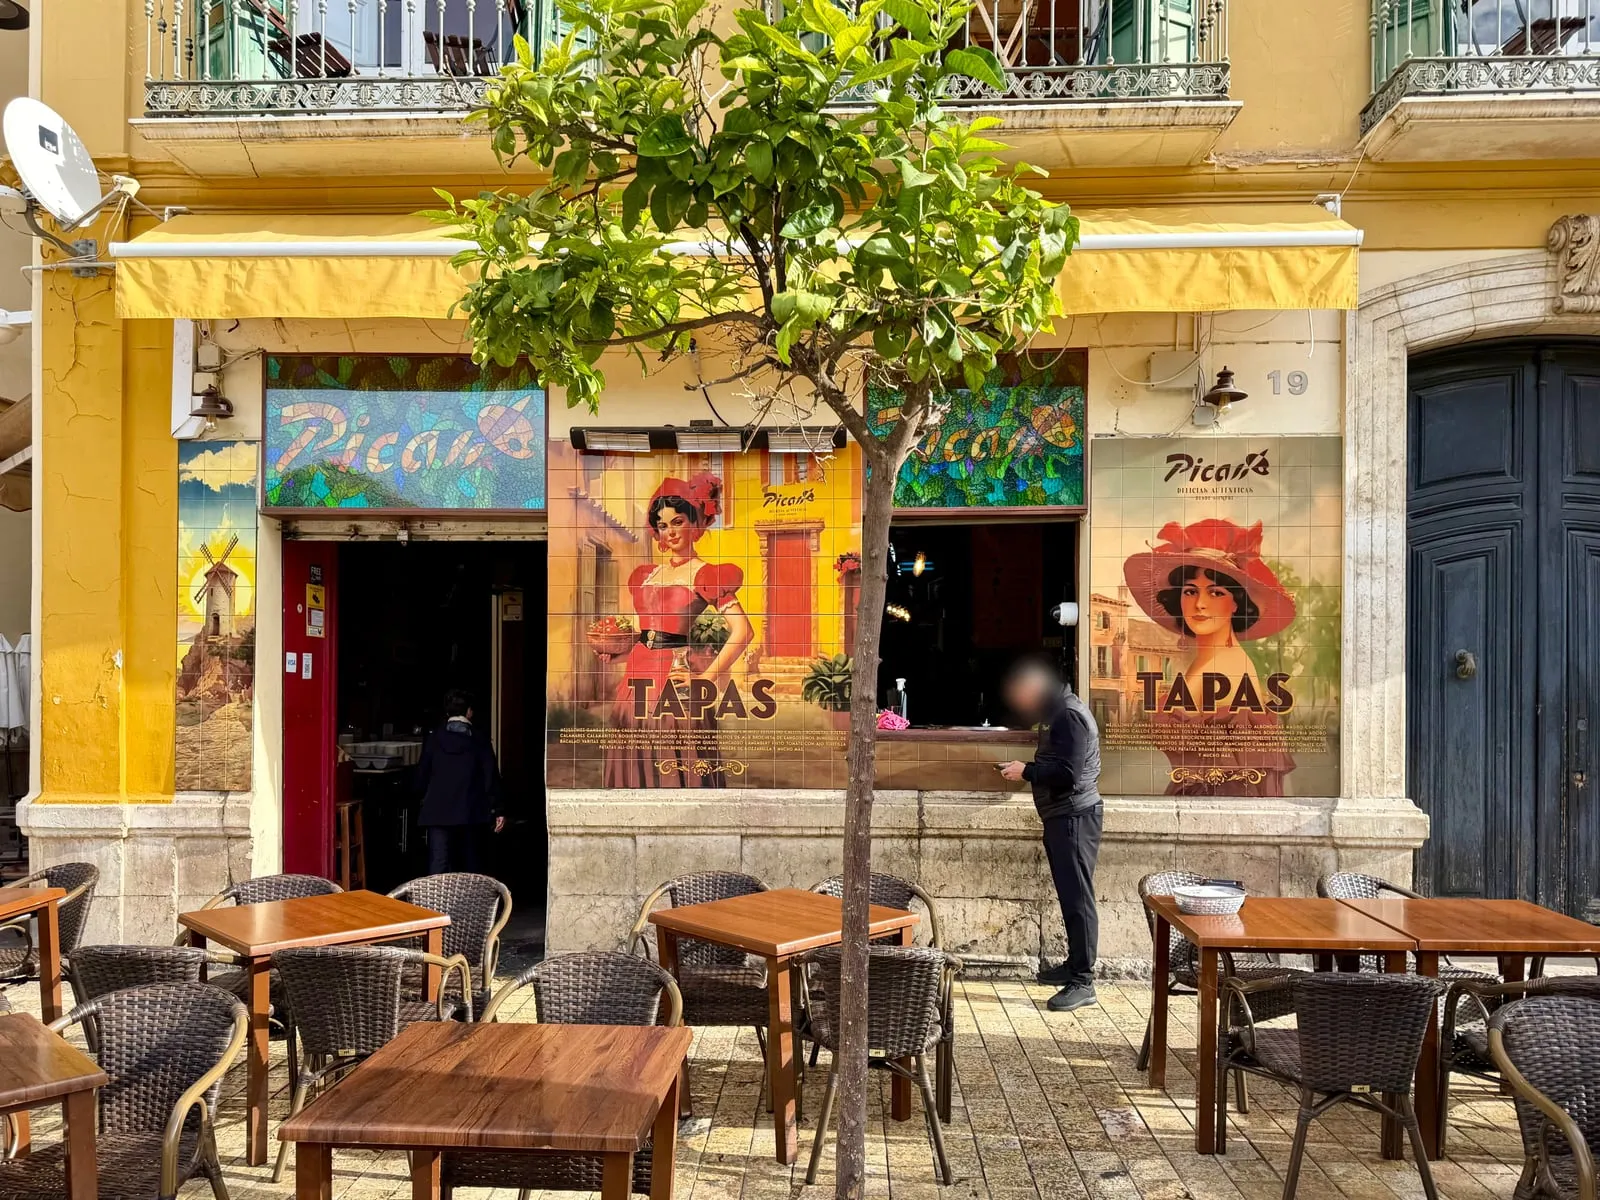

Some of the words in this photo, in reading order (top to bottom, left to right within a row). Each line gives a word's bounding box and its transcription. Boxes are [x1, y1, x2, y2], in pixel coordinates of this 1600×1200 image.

[1267, 369, 1308, 396] 19
[628, 678, 777, 721] TAPAS
[1137, 672, 1294, 714] TAPAS
